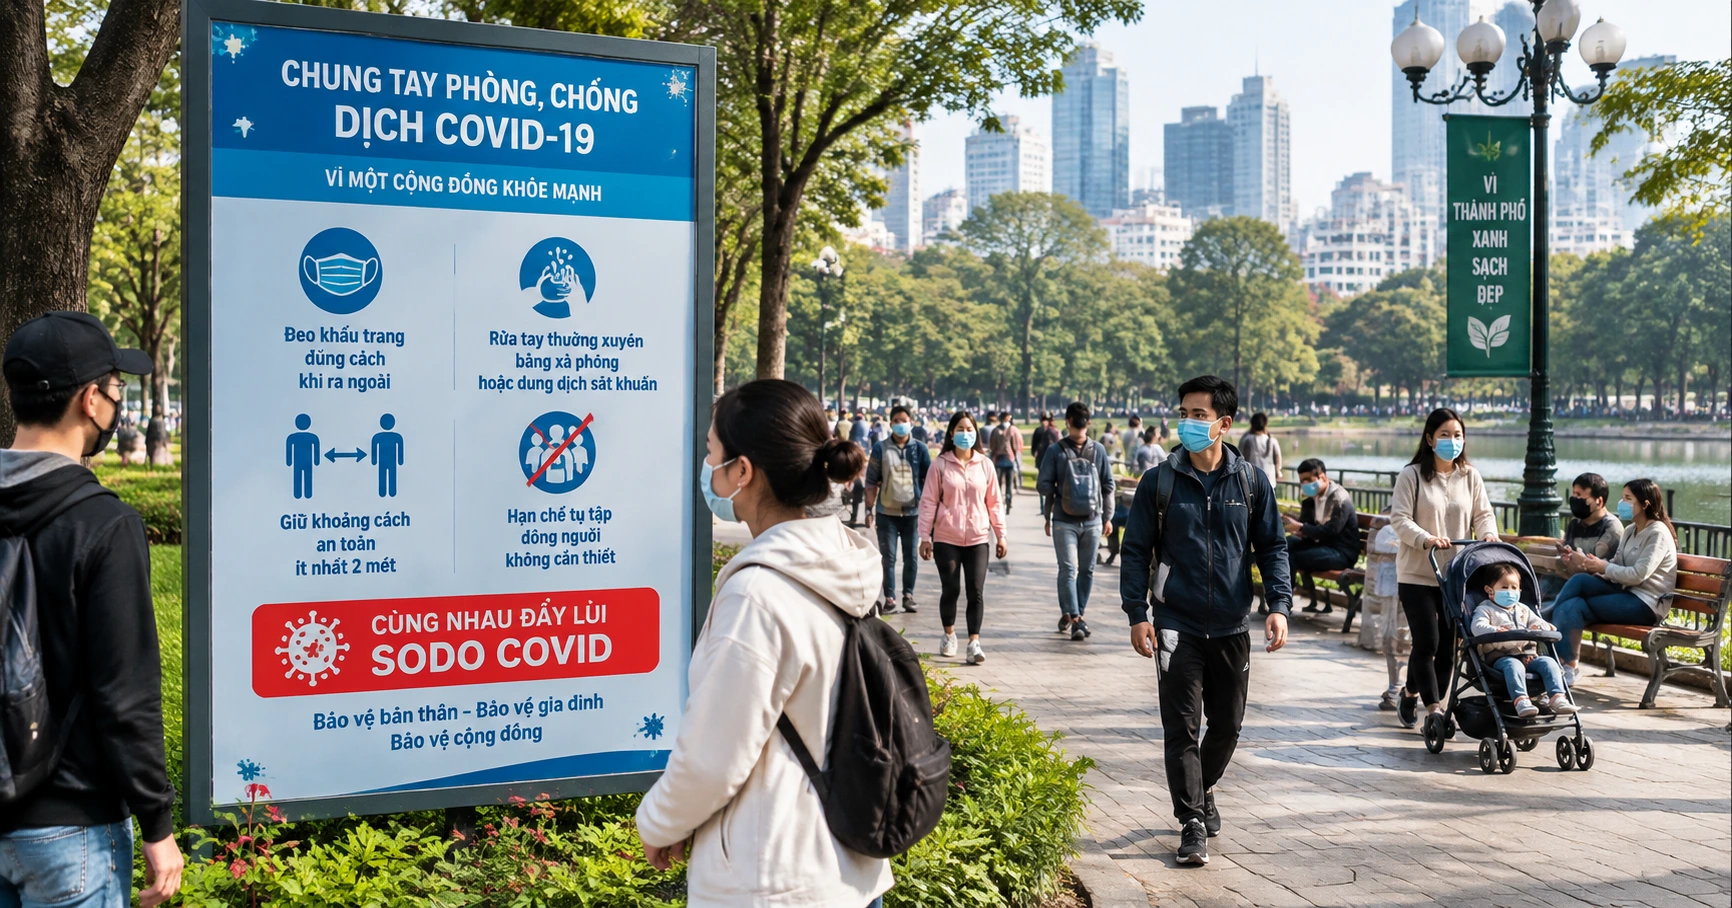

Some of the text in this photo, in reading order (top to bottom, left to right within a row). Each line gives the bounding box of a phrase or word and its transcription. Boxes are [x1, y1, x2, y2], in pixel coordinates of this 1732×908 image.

[282, 60, 637, 114] CHUNG TAY PHÒNG, CHỐNG
[336, 105, 594, 154] DỊCH COVID-19
[349, 167, 388, 193] MỘT
[394, 170, 443, 195] CỘNG
[553, 183, 601, 204] MẠNH
[1473, 230, 1507, 247] XANH
[363, 329, 404, 347] trang
[521, 332, 544, 349] tay
[300, 373, 322, 388] khi
[328, 377, 343, 388] ra
[518, 375, 553, 394] dung
[557, 376, 586, 393] dịch
[374, 511, 410, 527] cách
[508, 509, 536, 526] Hạn
[570, 508, 584, 524] tụ
[588, 506, 612, 524] tập
[317, 540, 336, 552] an
[352, 559, 361, 573] 2
[366, 557, 396, 573] mét
[506, 552, 550, 569] không
[372, 610, 438, 635] CÙNG
[447, 609, 512, 631] NHAU
[372, 634, 612, 676] SODO COVID
[418, 704, 457, 722] thân
[539, 696, 563, 717] gia
